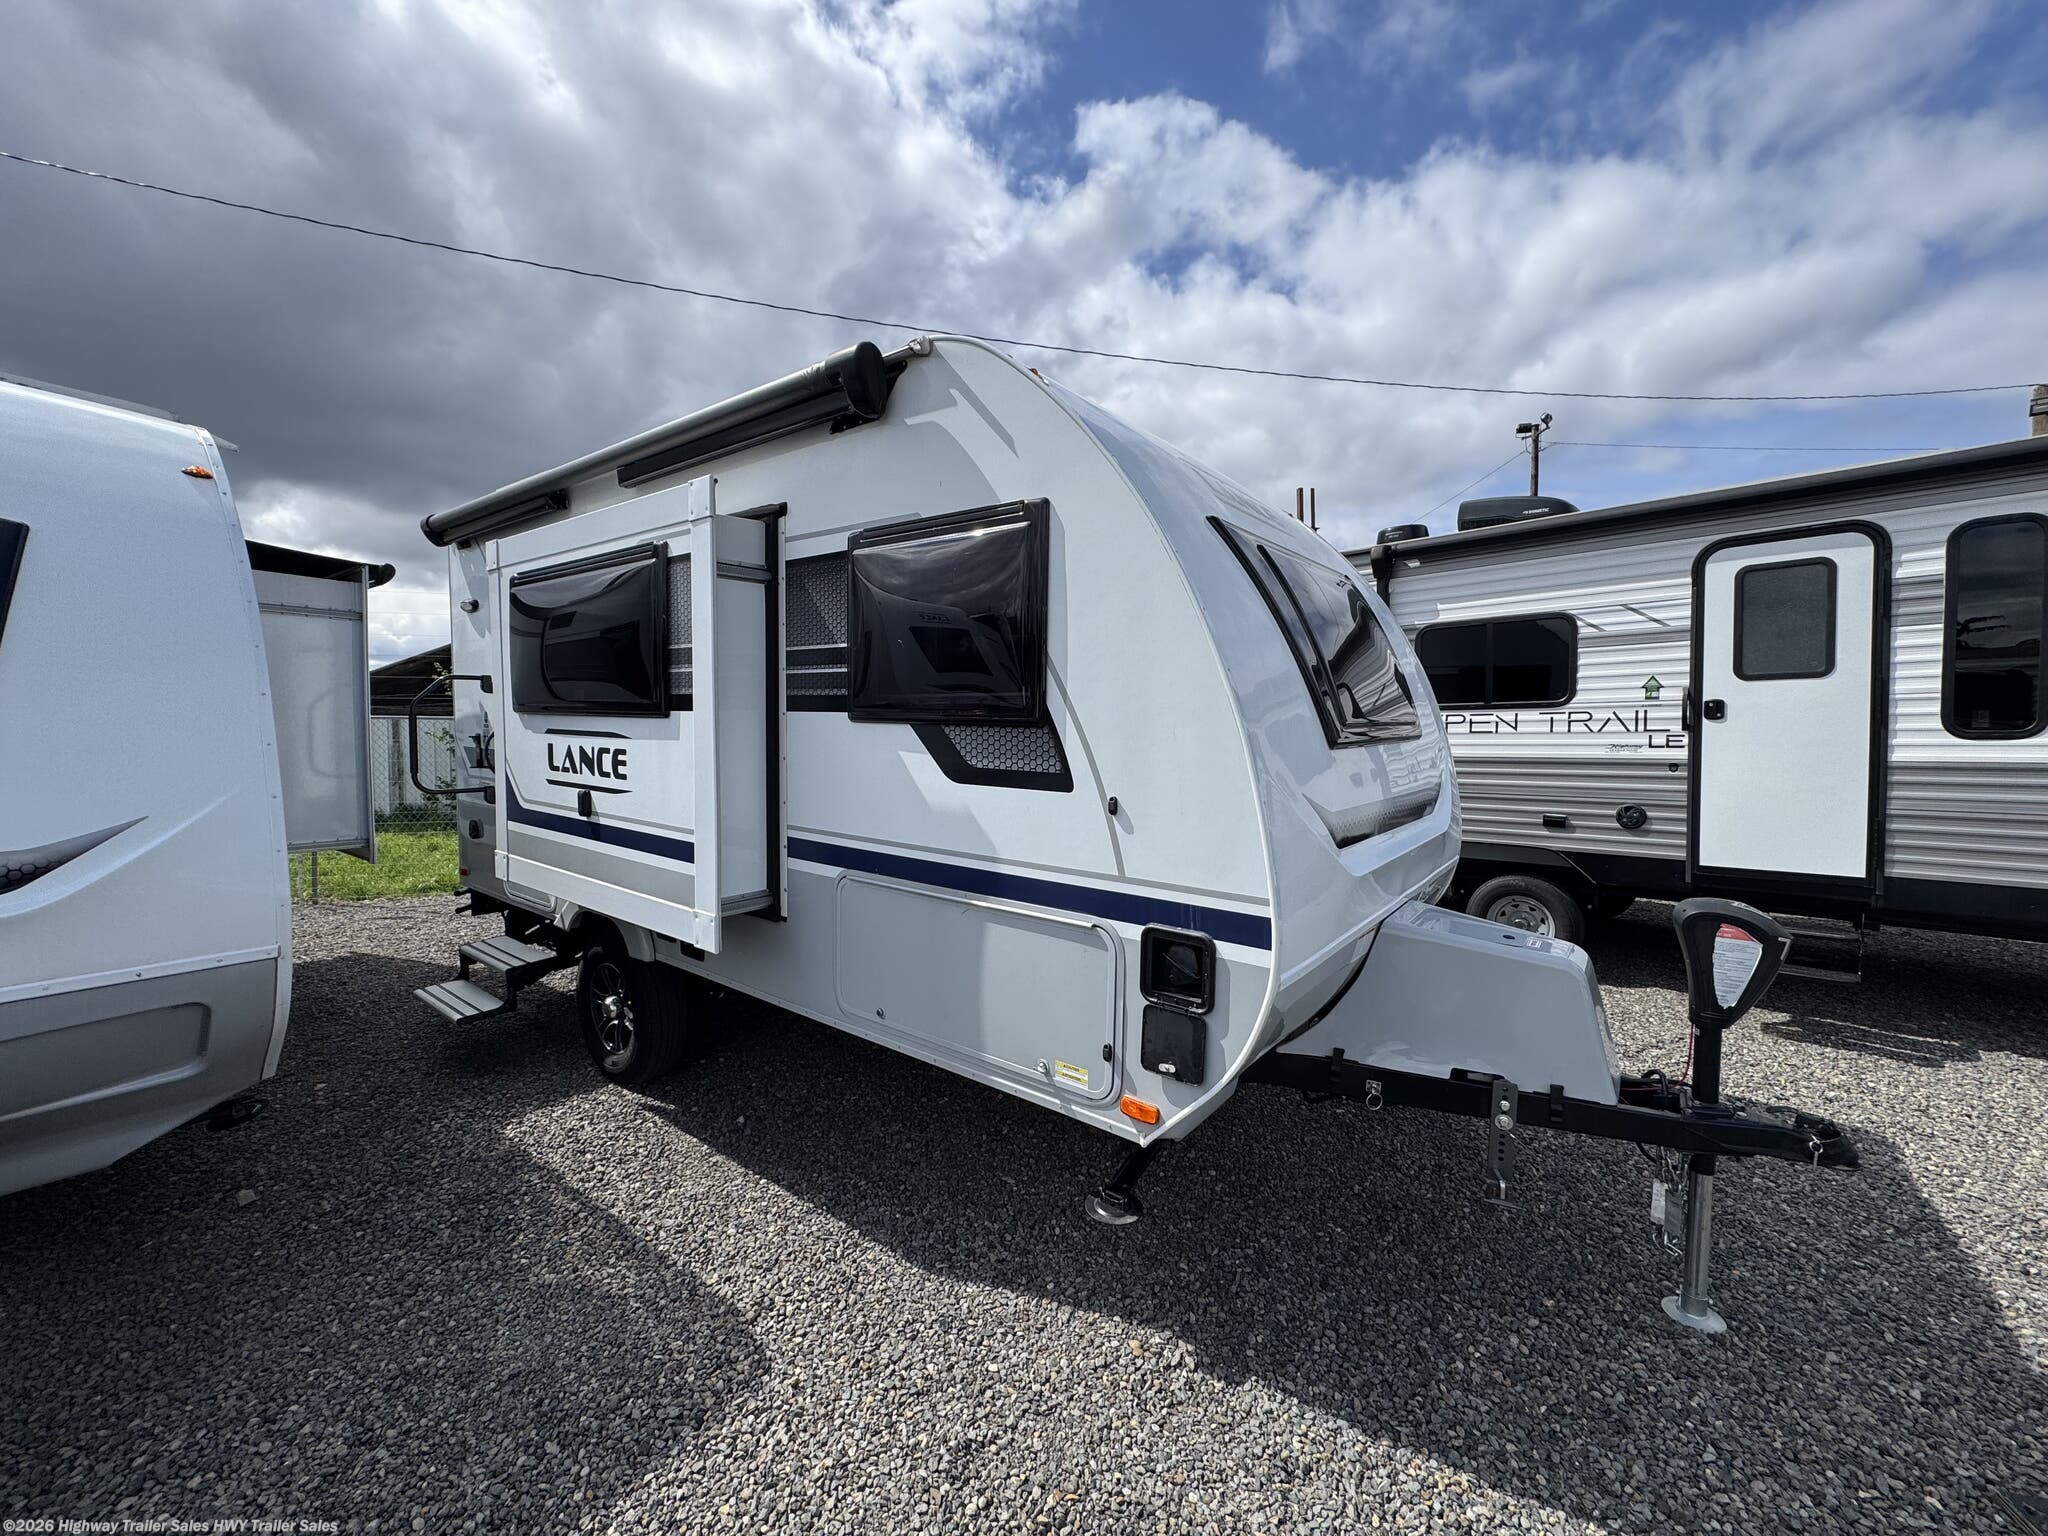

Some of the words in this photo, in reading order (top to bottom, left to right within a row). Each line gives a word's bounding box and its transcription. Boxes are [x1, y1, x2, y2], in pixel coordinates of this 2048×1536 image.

[1441, 712, 1518, 734] PEN
[1539, 710, 1671, 733] TRAIL
[1648, 734, 1686, 749] LE
[547, 742, 628, 781] LANCE
